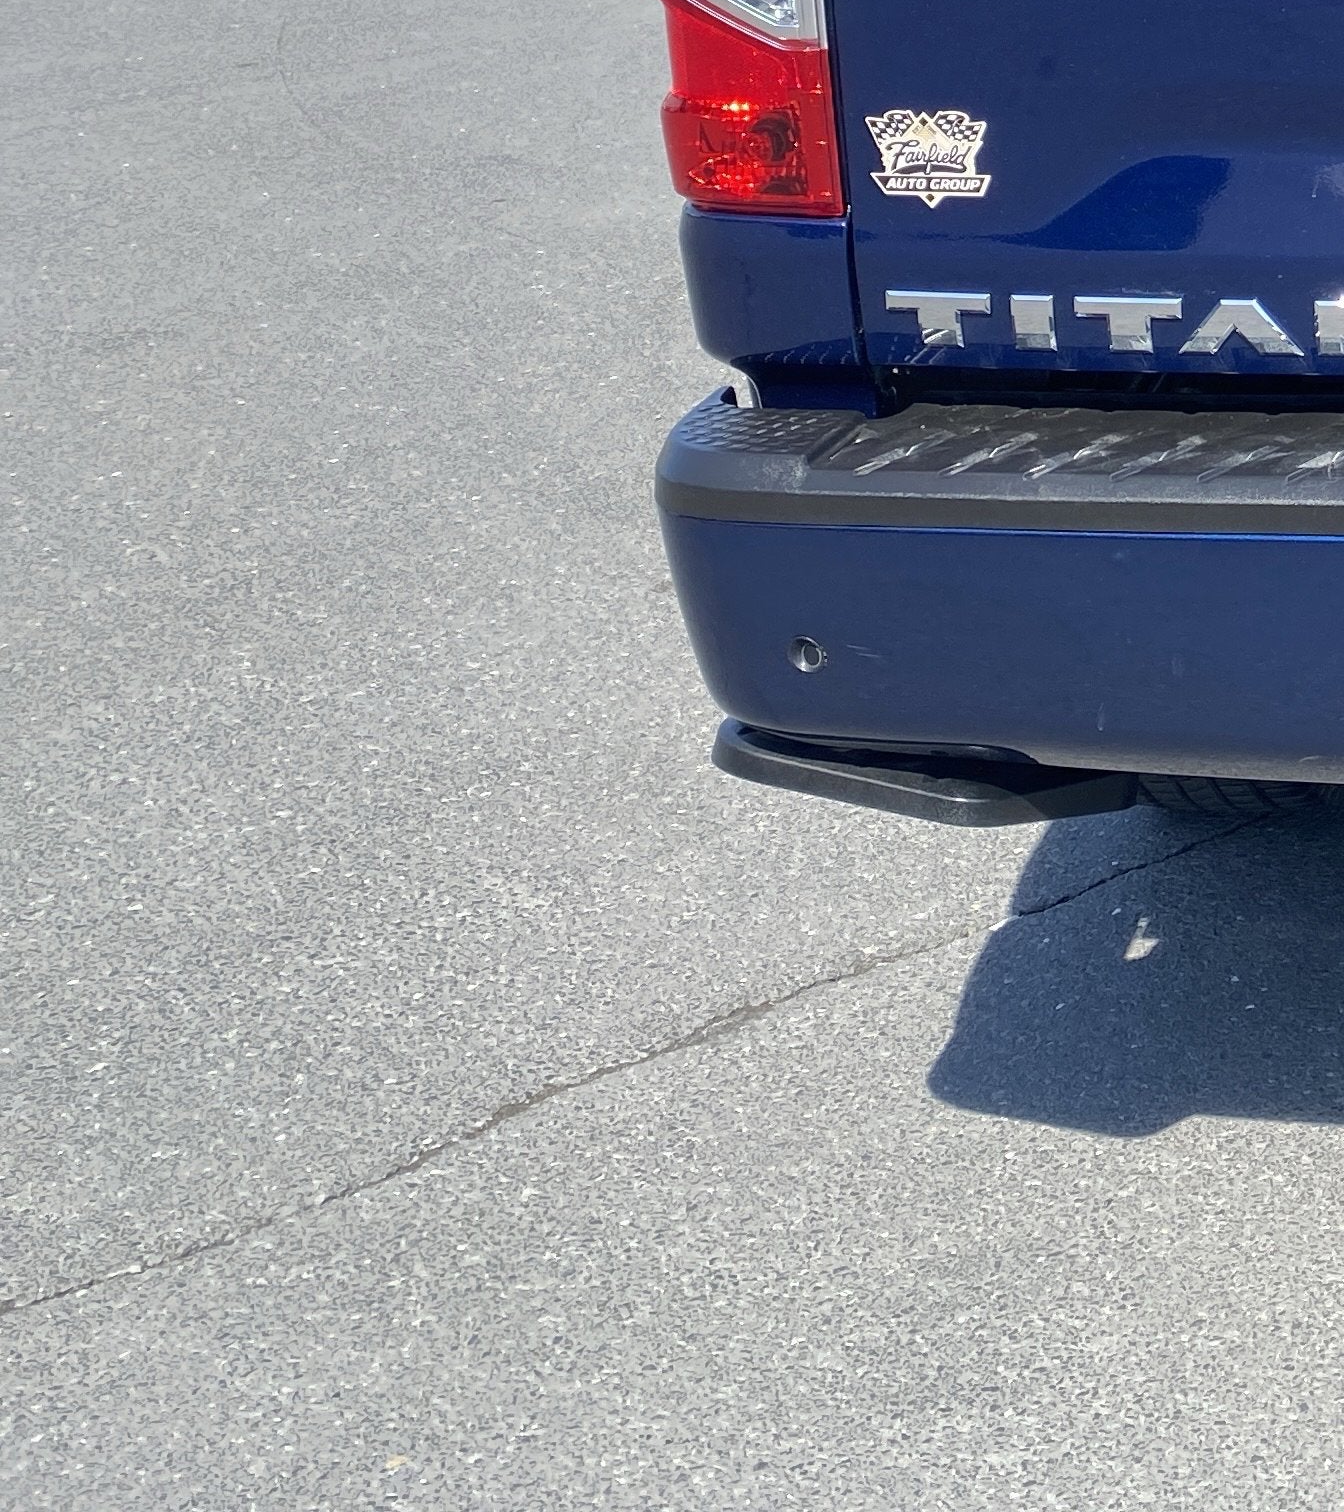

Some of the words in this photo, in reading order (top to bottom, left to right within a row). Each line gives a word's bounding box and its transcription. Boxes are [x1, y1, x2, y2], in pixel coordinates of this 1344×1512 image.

[885, 139, 972, 174] Fairfield
[886, 177, 926, 189] AUTO
[929, 178, 981, 191] GROUP
